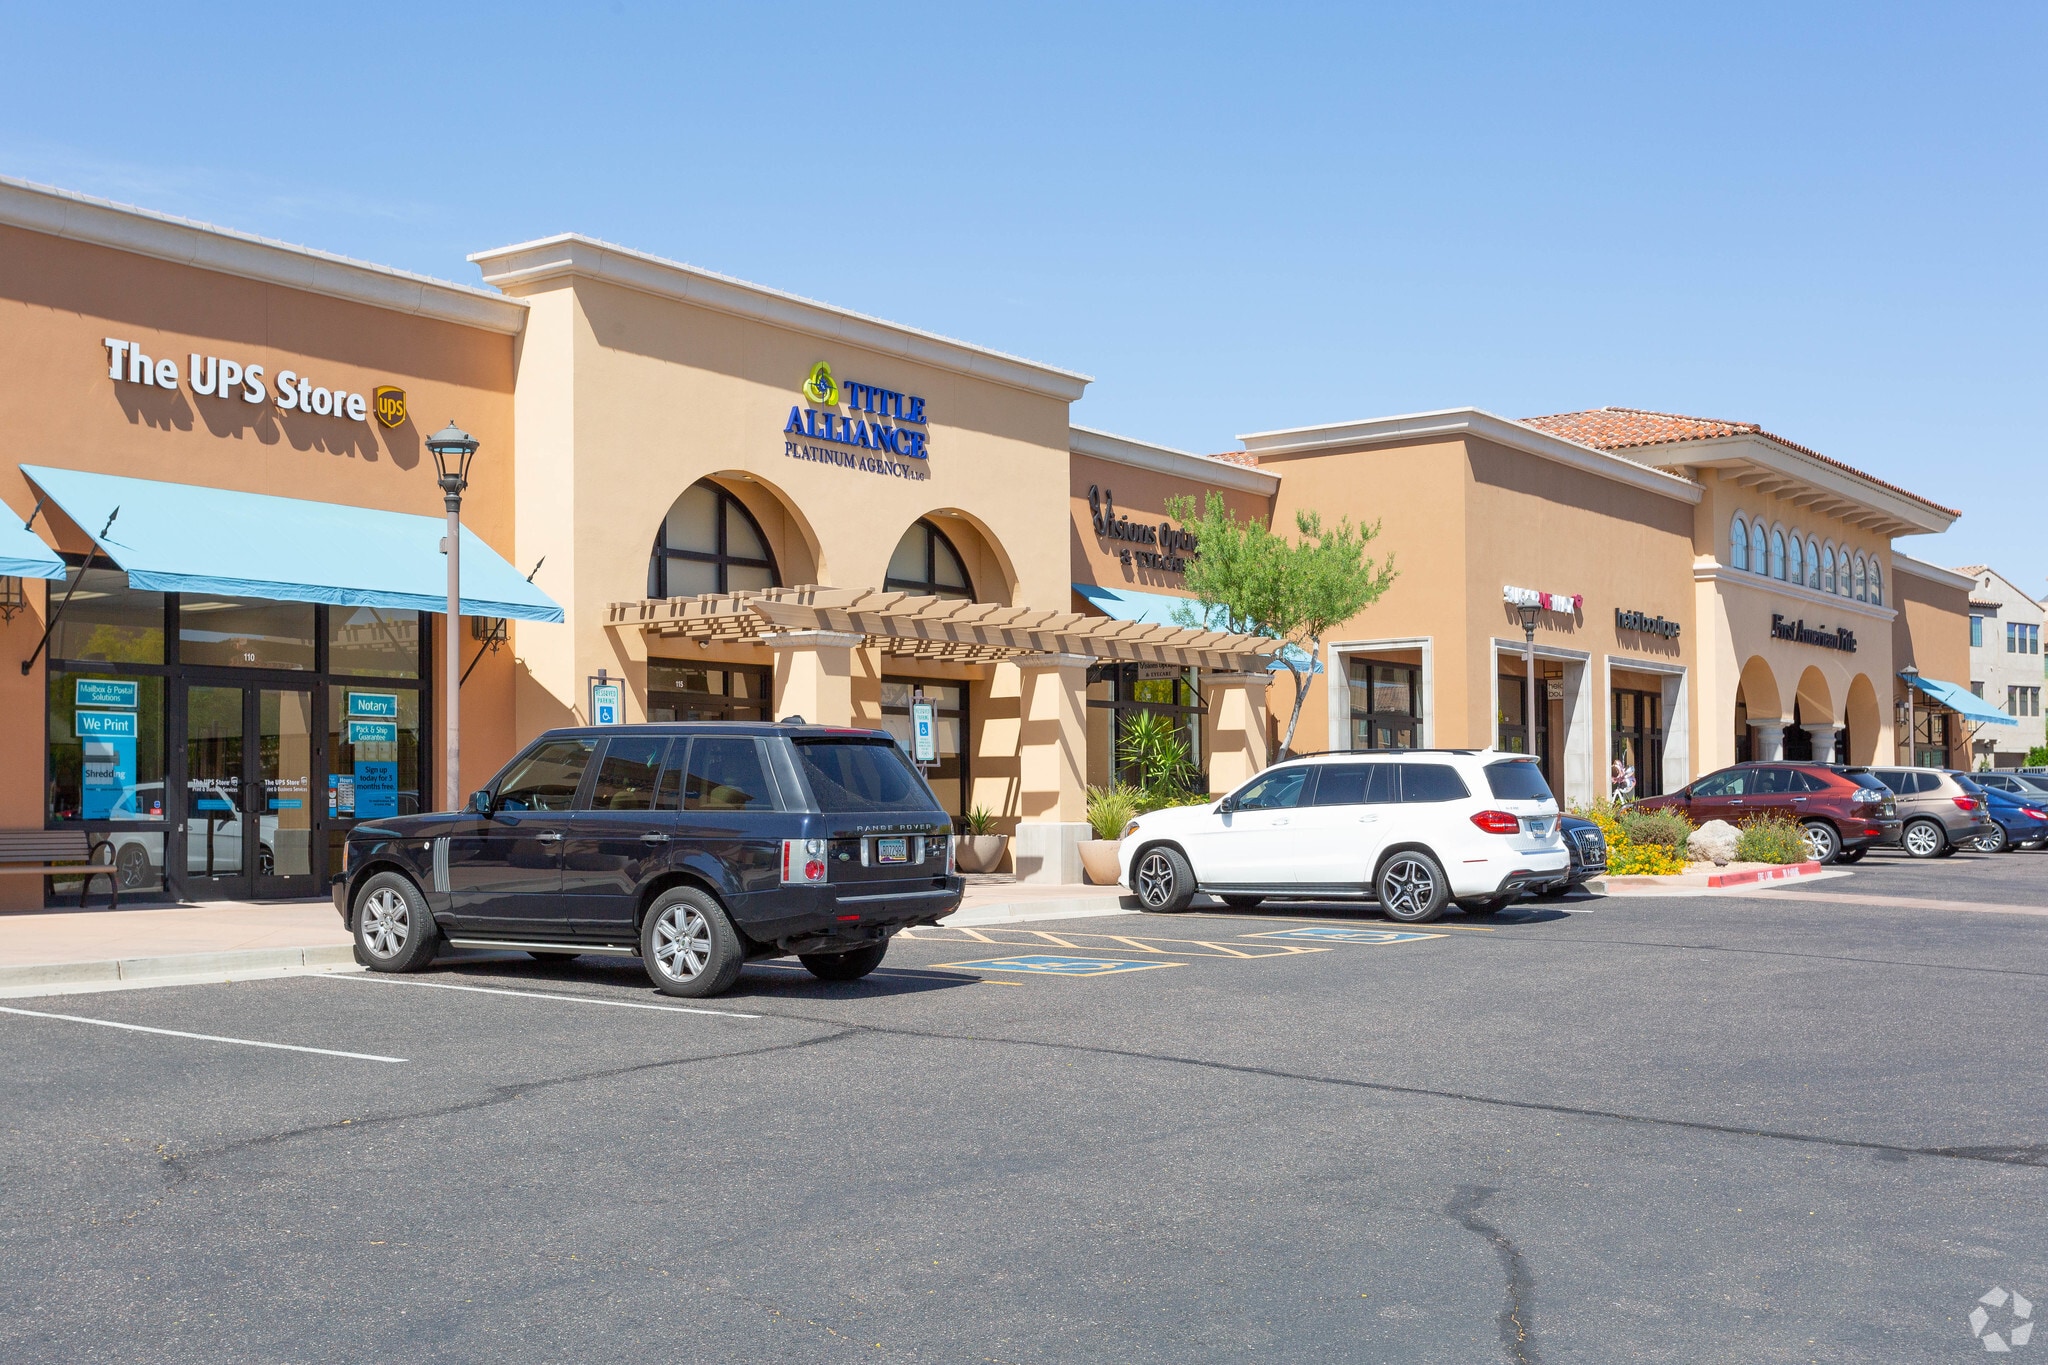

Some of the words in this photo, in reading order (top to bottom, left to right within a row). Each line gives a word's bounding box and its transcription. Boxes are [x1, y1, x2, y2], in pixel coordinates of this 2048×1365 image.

[104, 337, 179, 389] The
[188, 353, 266, 404] UPS
[274, 370, 367, 421] Store
[379, 396, 404, 420] ups
[844, 381, 927, 425] TITLE
[784, 406, 928, 460] ALLIANCE
[785, 441, 855, 469] PLATINUM
[1088, 485, 1157, 545] Visions
[1120, 548, 1132, 566] &
[1771, 613, 1796, 640] First
[1796, 619, 1839, 650] American
[1837, 627, 1857, 653] Title
[243, 652, 256, 662] 110
[80, 684, 106, 693] Mailbox
[107, 685, 112, 693] &
[114, 686, 133, 694] Postal
[675, 680, 684, 688] 115
[92, 692, 120, 702] Solutions
[358, 699, 388, 714] Notary
[83, 717, 101, 730] We
[104, 718, 129, 731] Print
[356, 725, 369, 733] Pack
[370, 725, 375, 733] &
[376, 726, 388, 735] Ship
[358, 733, 386, 742] Guarantee
[86, 769, 126, 780] Shredding
[365, 766, 379, 774] Sign
[856, 824, 893, 832] RANGE
